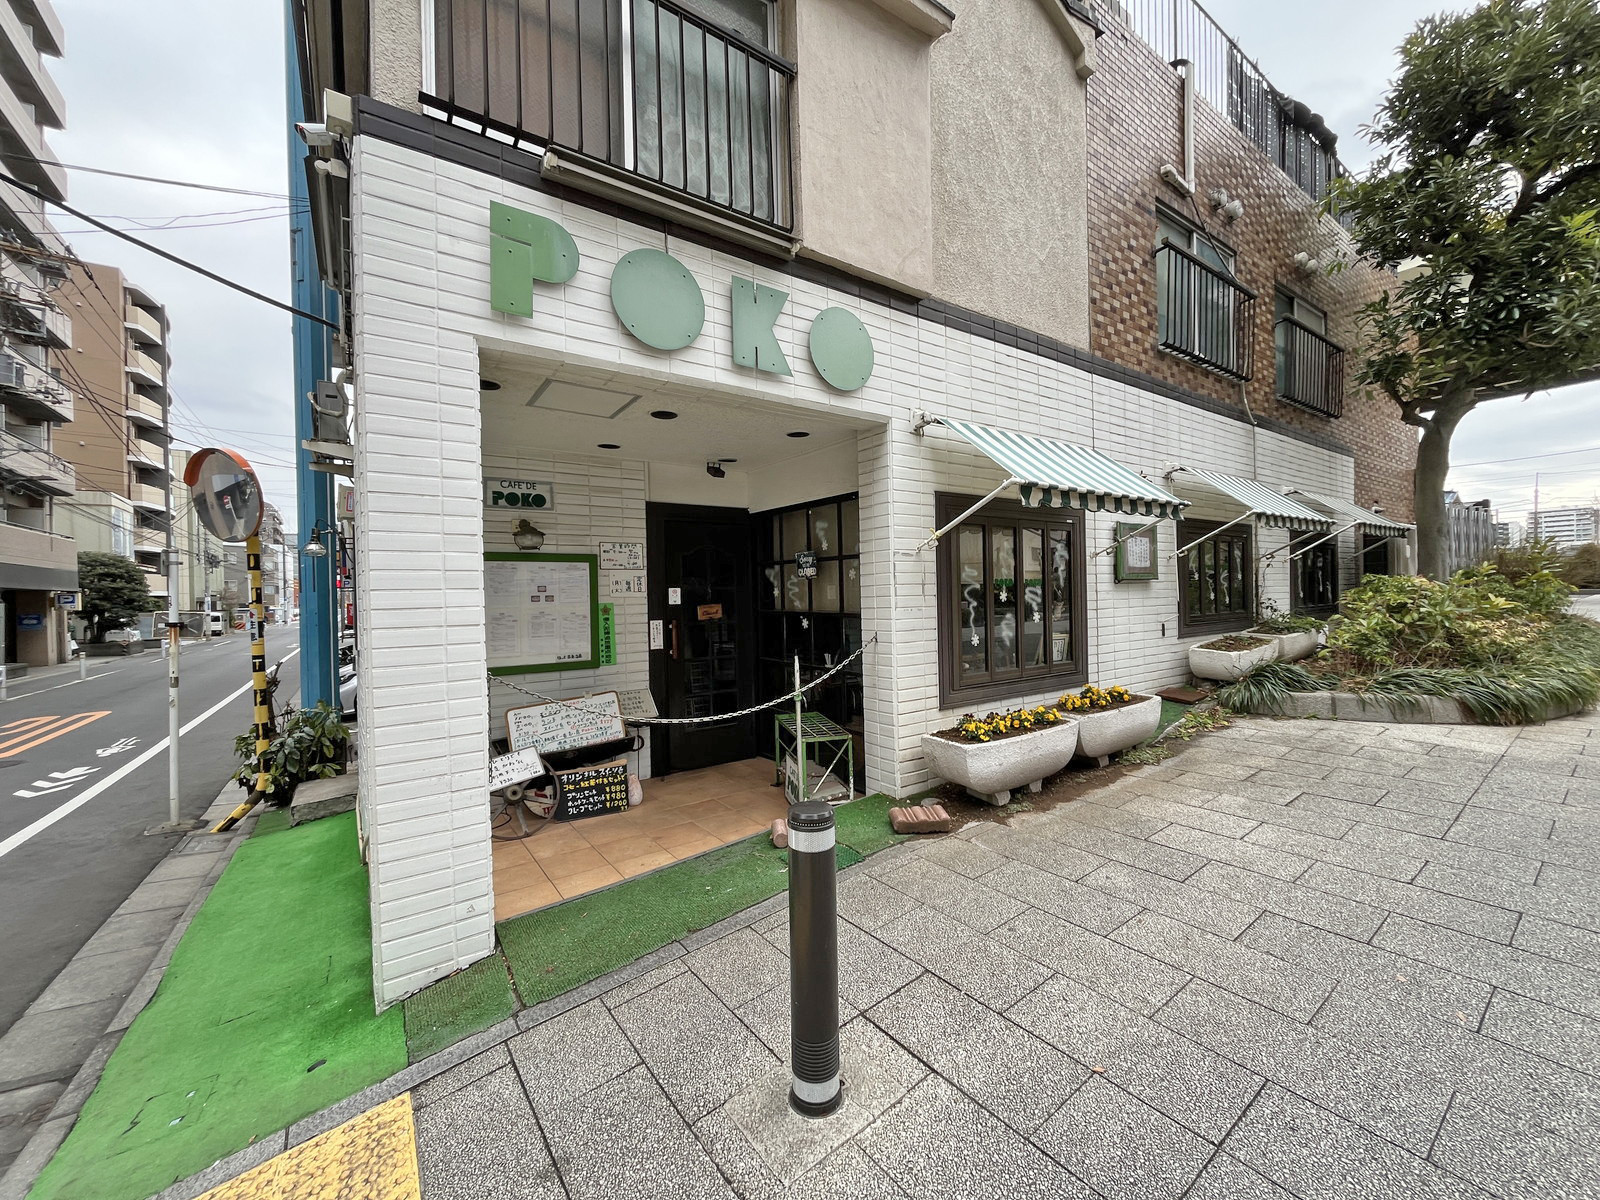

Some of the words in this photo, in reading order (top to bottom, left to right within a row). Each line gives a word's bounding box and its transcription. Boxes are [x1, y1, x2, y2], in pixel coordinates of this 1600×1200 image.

[490, 200, 875, 391] POKO
[526, 482, 537, 491] DE
[492, 491, 547, 508] POKO
[605, 784, 626, 793] ¥880
[605, 792, 627, 801] ¥980
